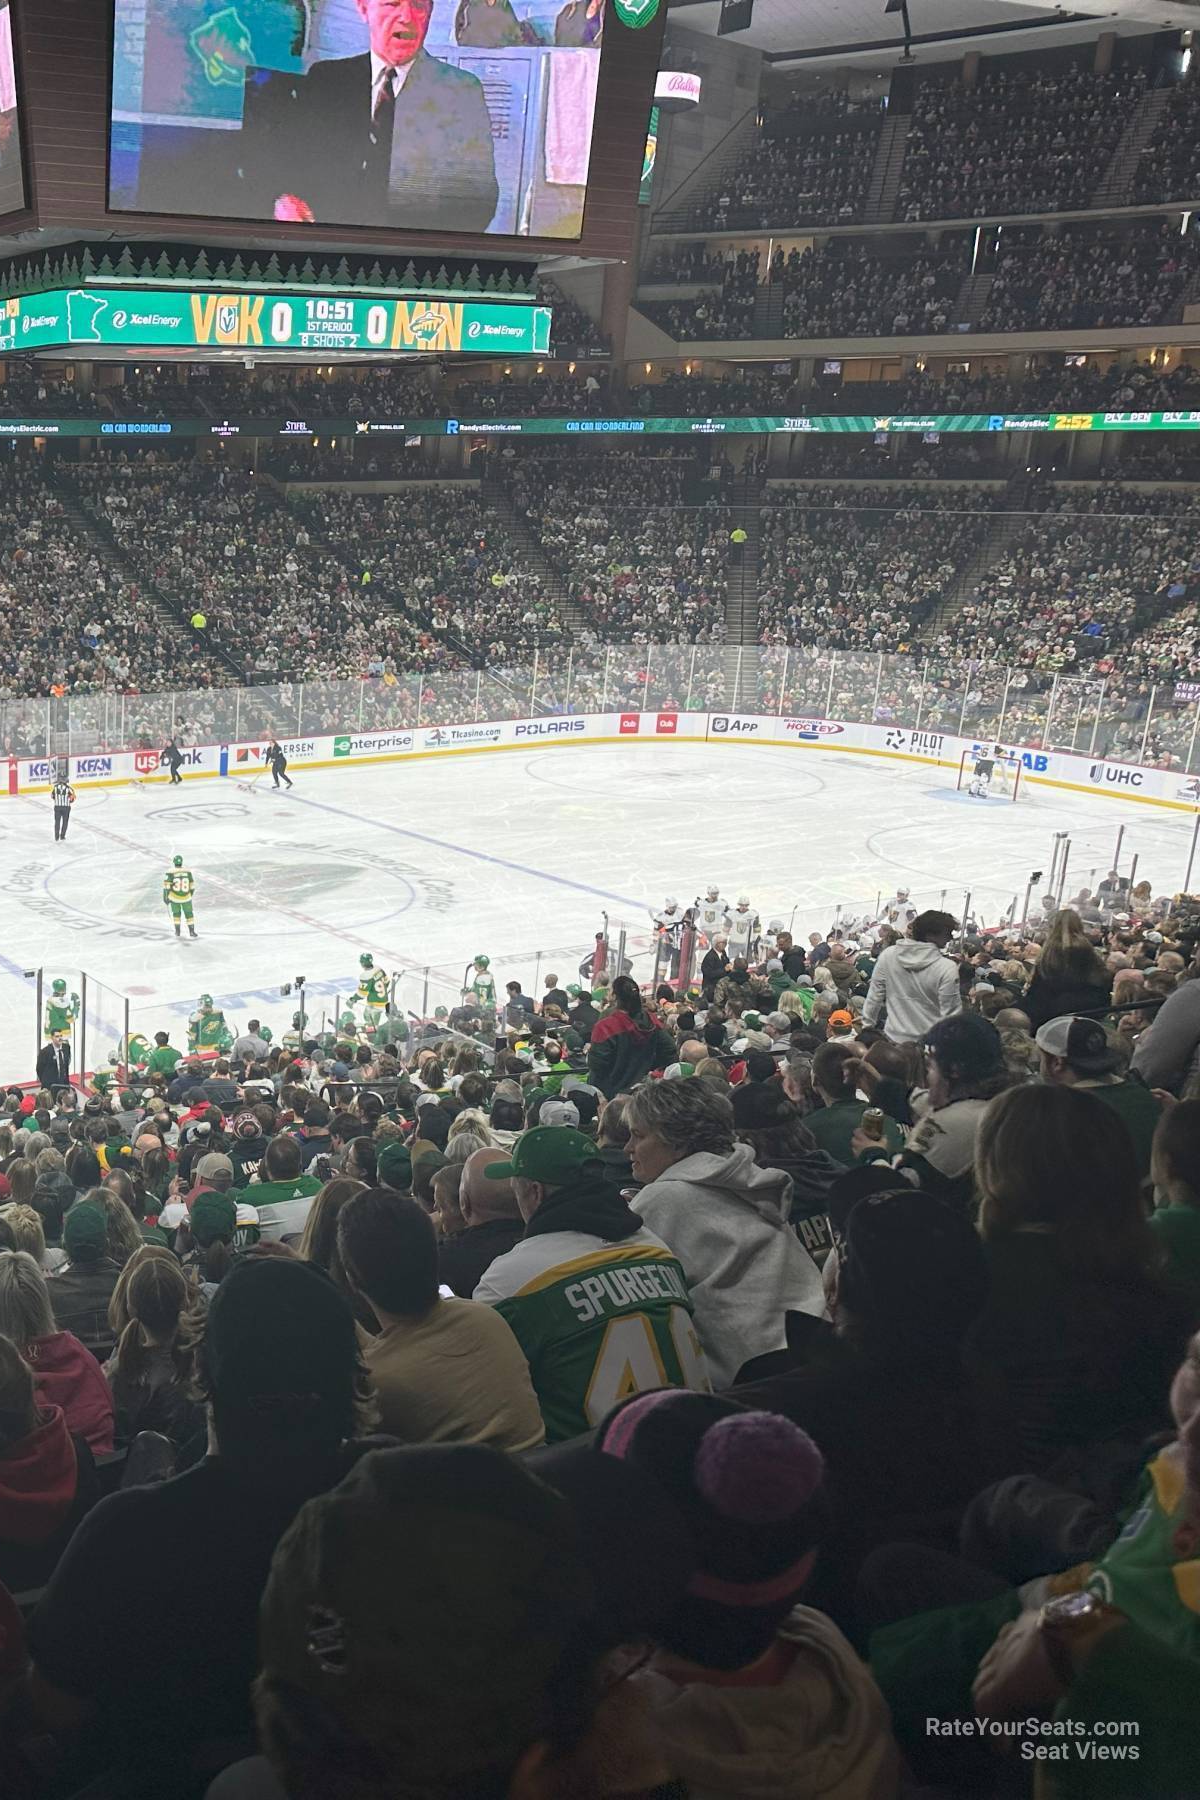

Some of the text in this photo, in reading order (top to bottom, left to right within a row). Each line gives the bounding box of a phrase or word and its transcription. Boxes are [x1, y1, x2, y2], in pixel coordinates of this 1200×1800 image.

[306, 300, 353, 320] 10:51
[271, 302, 292, 341] 0
[307, 321, 352, 332] 1ST PERIOD
[367, 305, 388, 344] 0
[301, 334, 357, 348] 8 SHOTS 2
[286, 421, 308, 431] STIFEL
[459, 424, 521, 432] RandysElectric.com
[783, 418, 812, 428] STIFEL
[1055, 415, 1092, 430] 2:52
[515, 720, 585, 737] POLARIS
[622, 720, 636, 728] Cub
[659, 720, 673, 728] Cub
[261, 742, 314, 756] AERSEN
[338, 736, 412, 753] enterprise
[910, 732, 945, 750] PILOT
[77, 757, 112, 773] KFAN
[137, 749, 202, 769] us bnk
[972, 744, 1048, 772] ELAB
[1106, 768, 1144, 786] UHC
[172, 877, 190, 892] 38
[801, 1215, 826, 1249] AP
